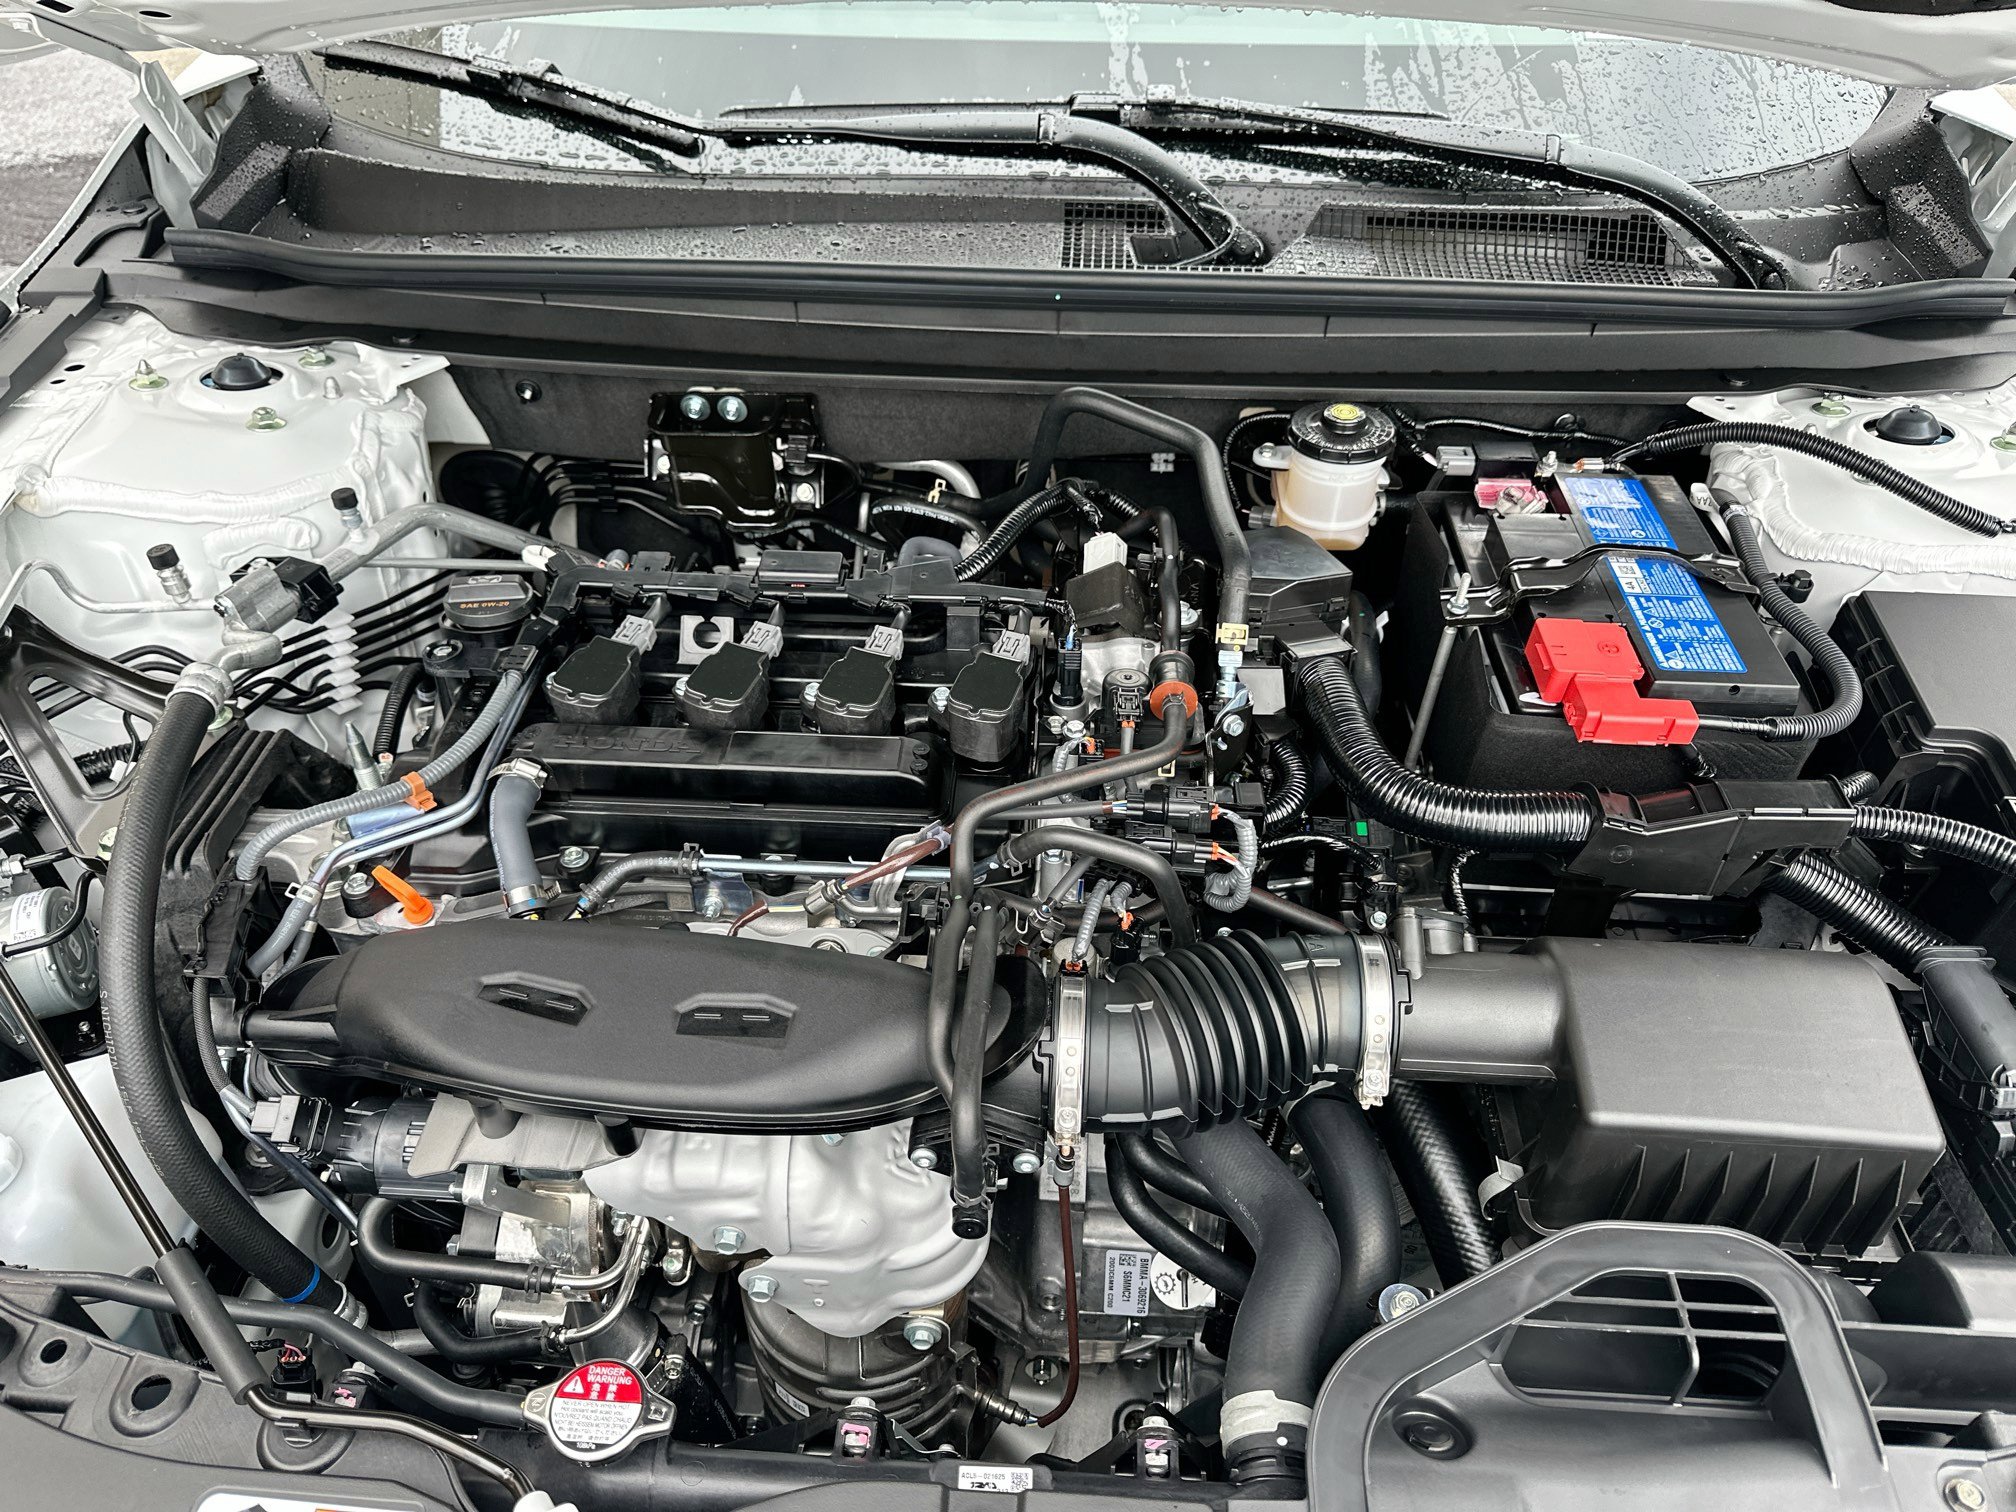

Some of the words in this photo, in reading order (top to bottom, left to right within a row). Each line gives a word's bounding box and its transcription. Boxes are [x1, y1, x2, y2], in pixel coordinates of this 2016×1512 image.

[553, 735, 701, 753] HONDA
[1122, 1270, 1133, 1302] S6MMC21
[588, 1365, 626, 1376] DANGER
[587, 1374, 632, 1385] WARNUNG
